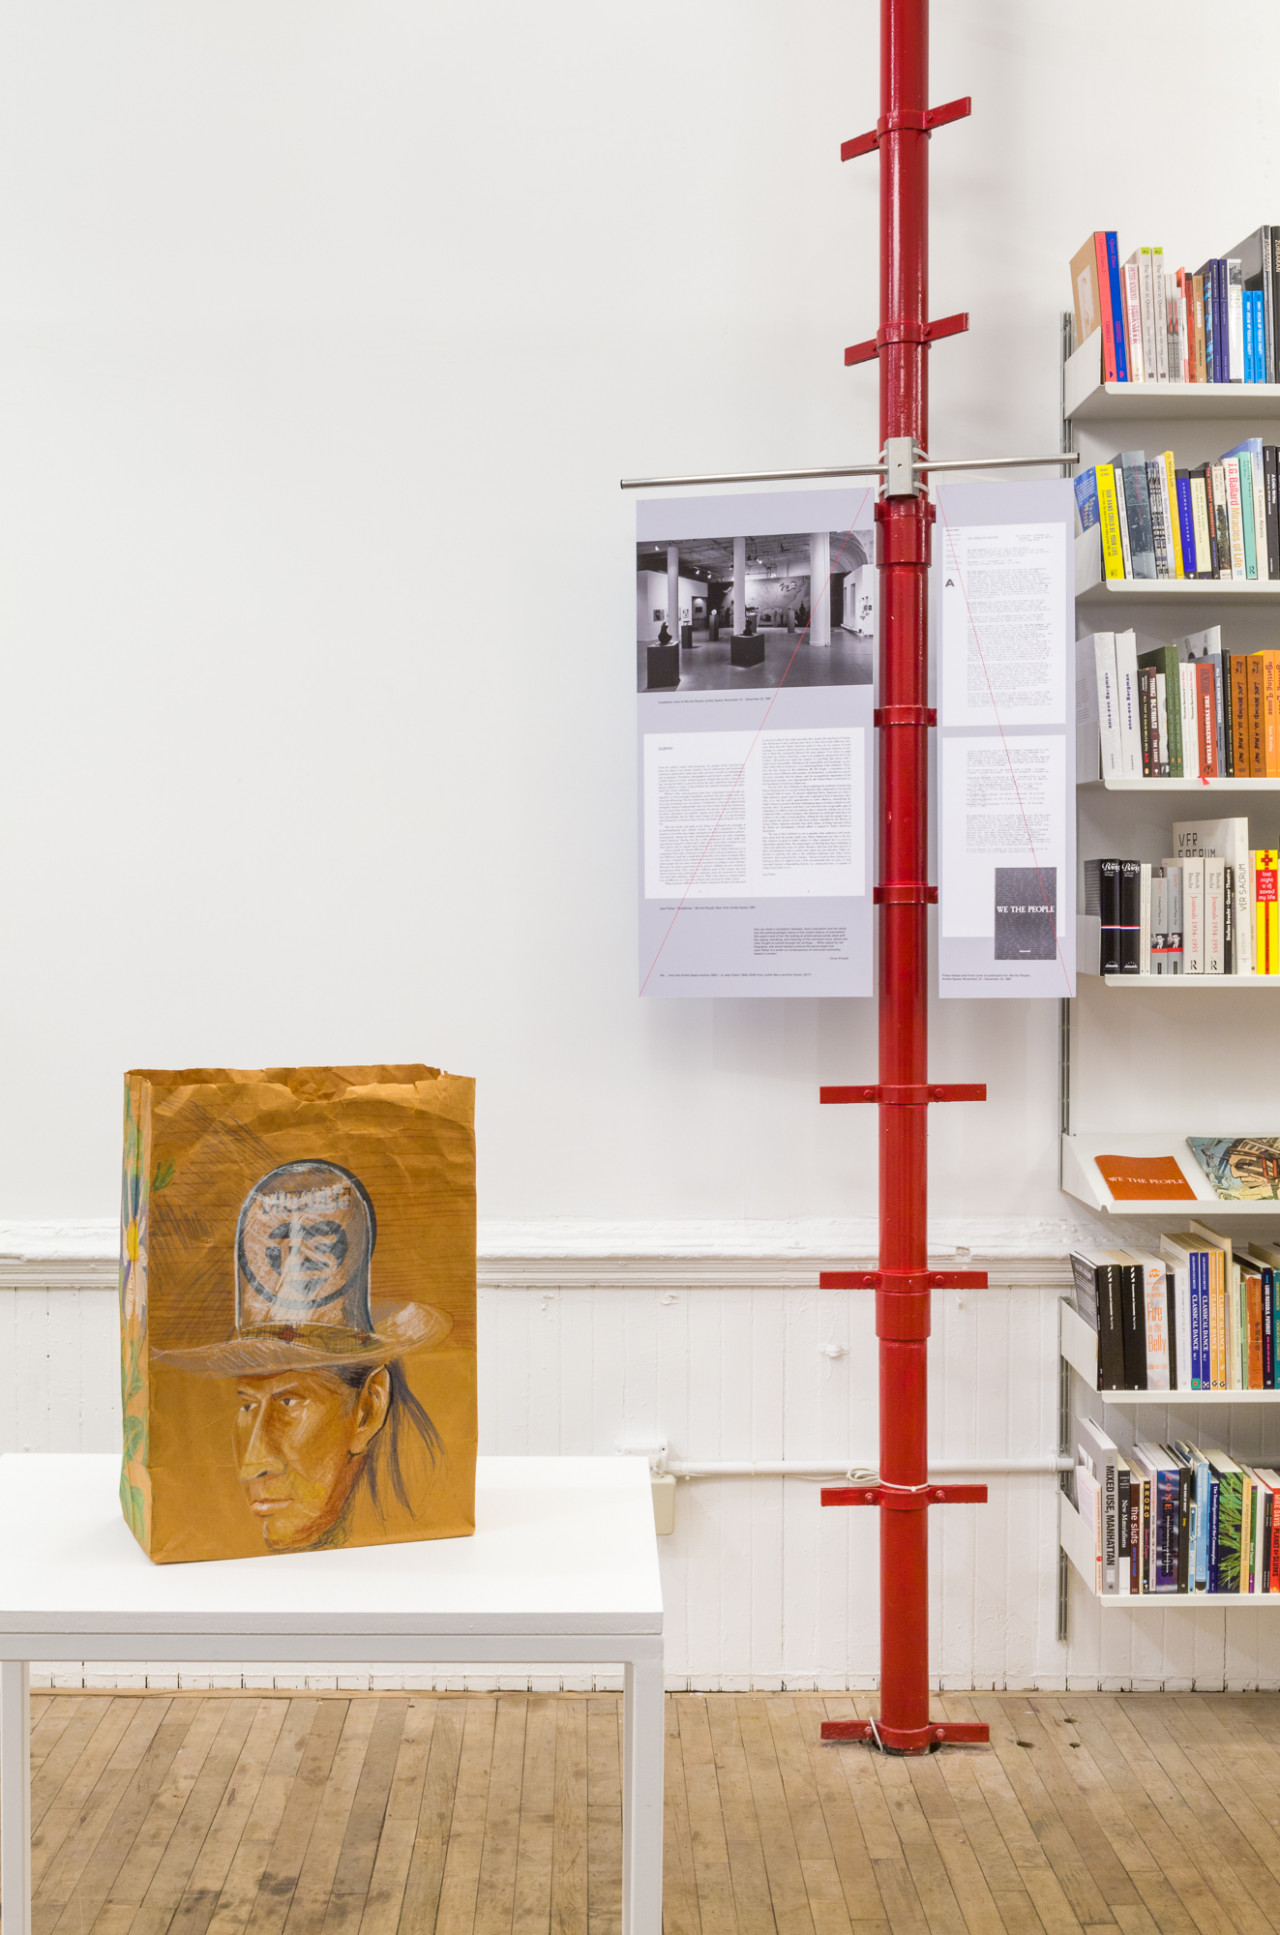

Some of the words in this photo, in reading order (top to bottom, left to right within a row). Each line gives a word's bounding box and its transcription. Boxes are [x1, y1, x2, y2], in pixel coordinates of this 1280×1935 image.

[1228, 463, 1238, 477] J.G.
[1229, 477, 1239, 505] Ballard
[1231, 507, 1242, 541] Miracles
[1233, 543, 1242, 551] of
[1233, 553, 1243, 568] Life
[945, 579, 955, 588] A
[1265, 661, 1274, 691] Getting
[1266, 693, 1274, 715] Loose
[1238, 863, 1247, 894] SACRUM
[996, 905, 1009, 913] WE
[1010, 905, 1026, 913] THE
[1027, 905, 1056, 913] PEOPLE
[1239, 896, 1247, 912] VER
[1147, 1302, 1163, 1322] Fire
[1153, 1322, 1162, 1333] the
[1148, 1334, 1167, 1356] Belly
[1106, 1465, 1114, 1495] MIXED
[1164, 1473, 1172, 1510] ZONE
[1104, 1495, 1115, 1513] USE,
[1131, 1506, 1139, 1521] the
[1106, 1515, 1115, 1566] MANHATTAN
[1131, 1523, 1139, 1544] sluts
